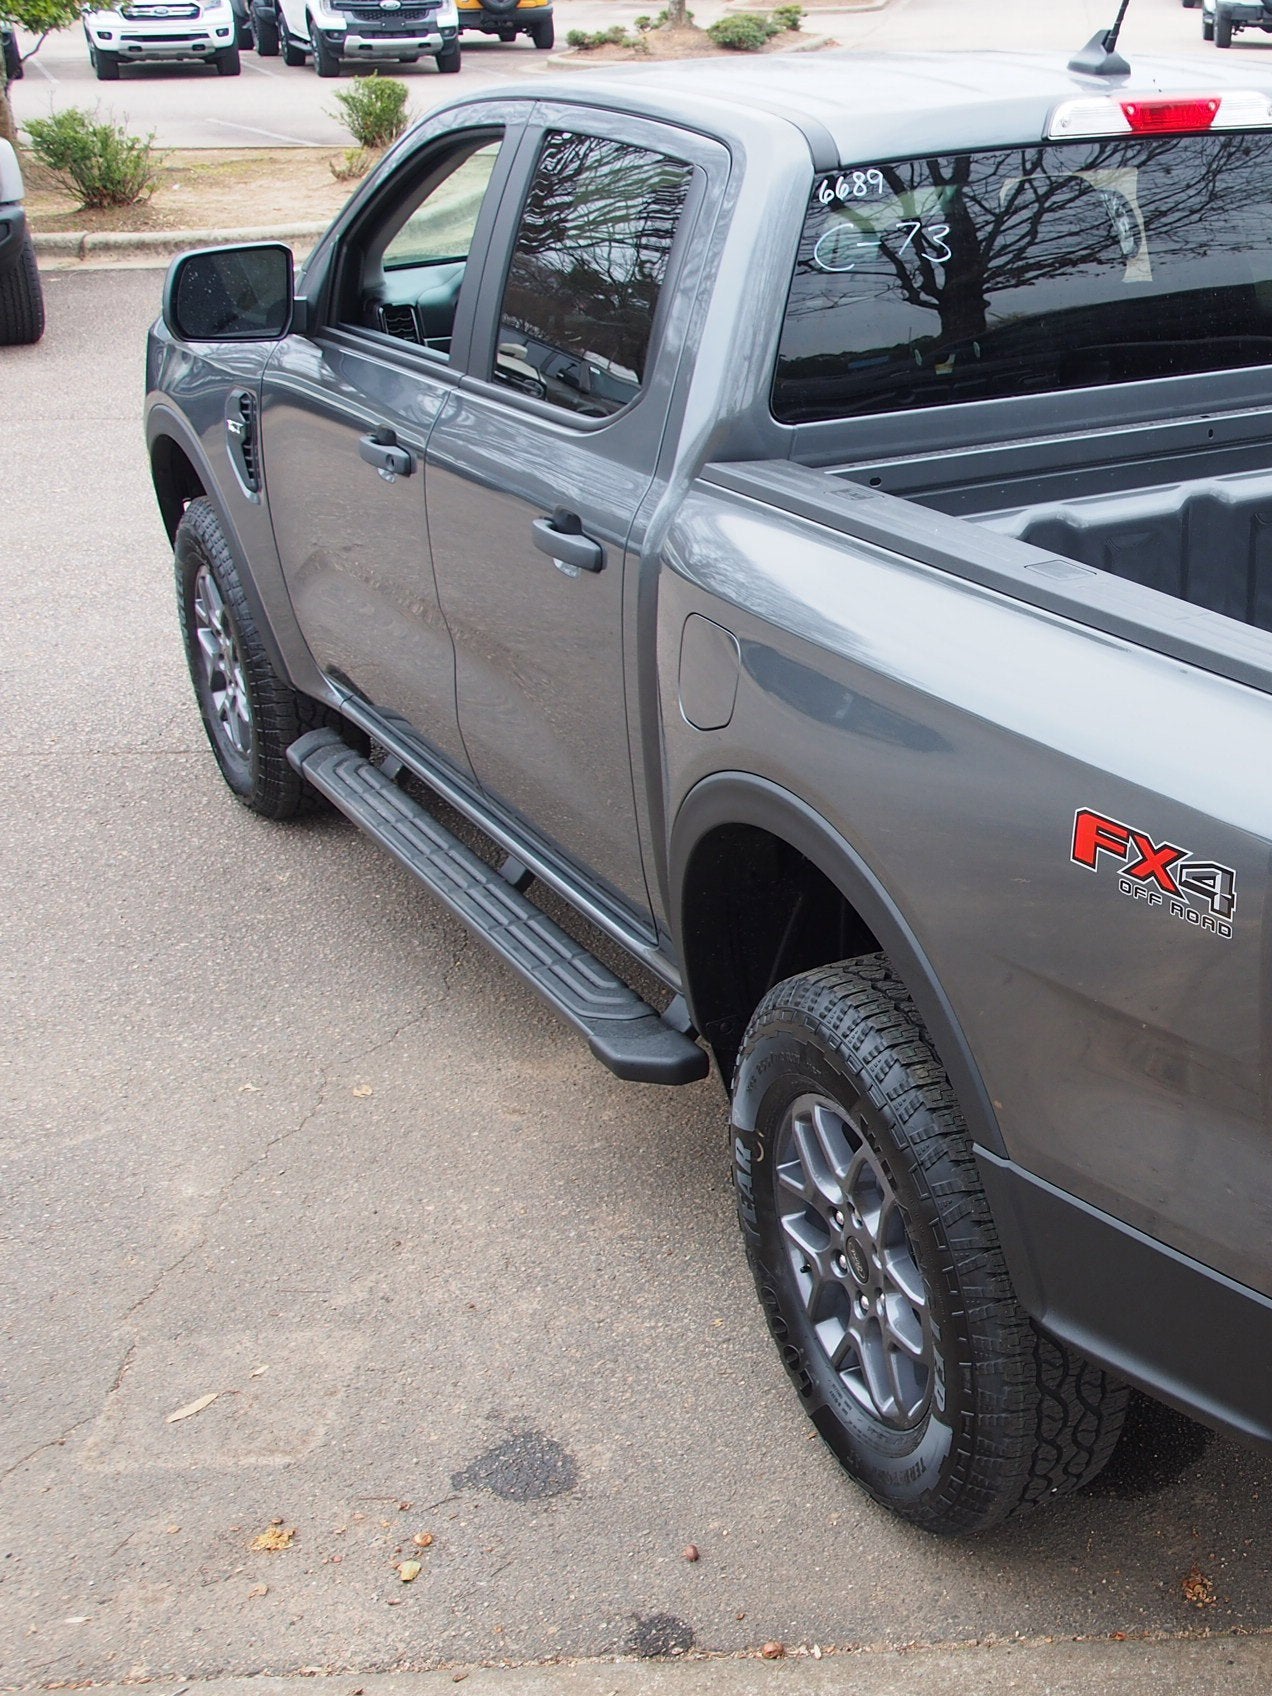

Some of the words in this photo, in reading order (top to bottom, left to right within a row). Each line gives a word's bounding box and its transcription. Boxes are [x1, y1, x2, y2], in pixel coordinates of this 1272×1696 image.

[818, 169, 884, 204] 6689
[813, 222, 952, 272] C-73
[1070, 807, 1237, 922] FX4
[1119, 879, 1162, 905] OFF
[1170, 900, 1232, 939] ROAD
